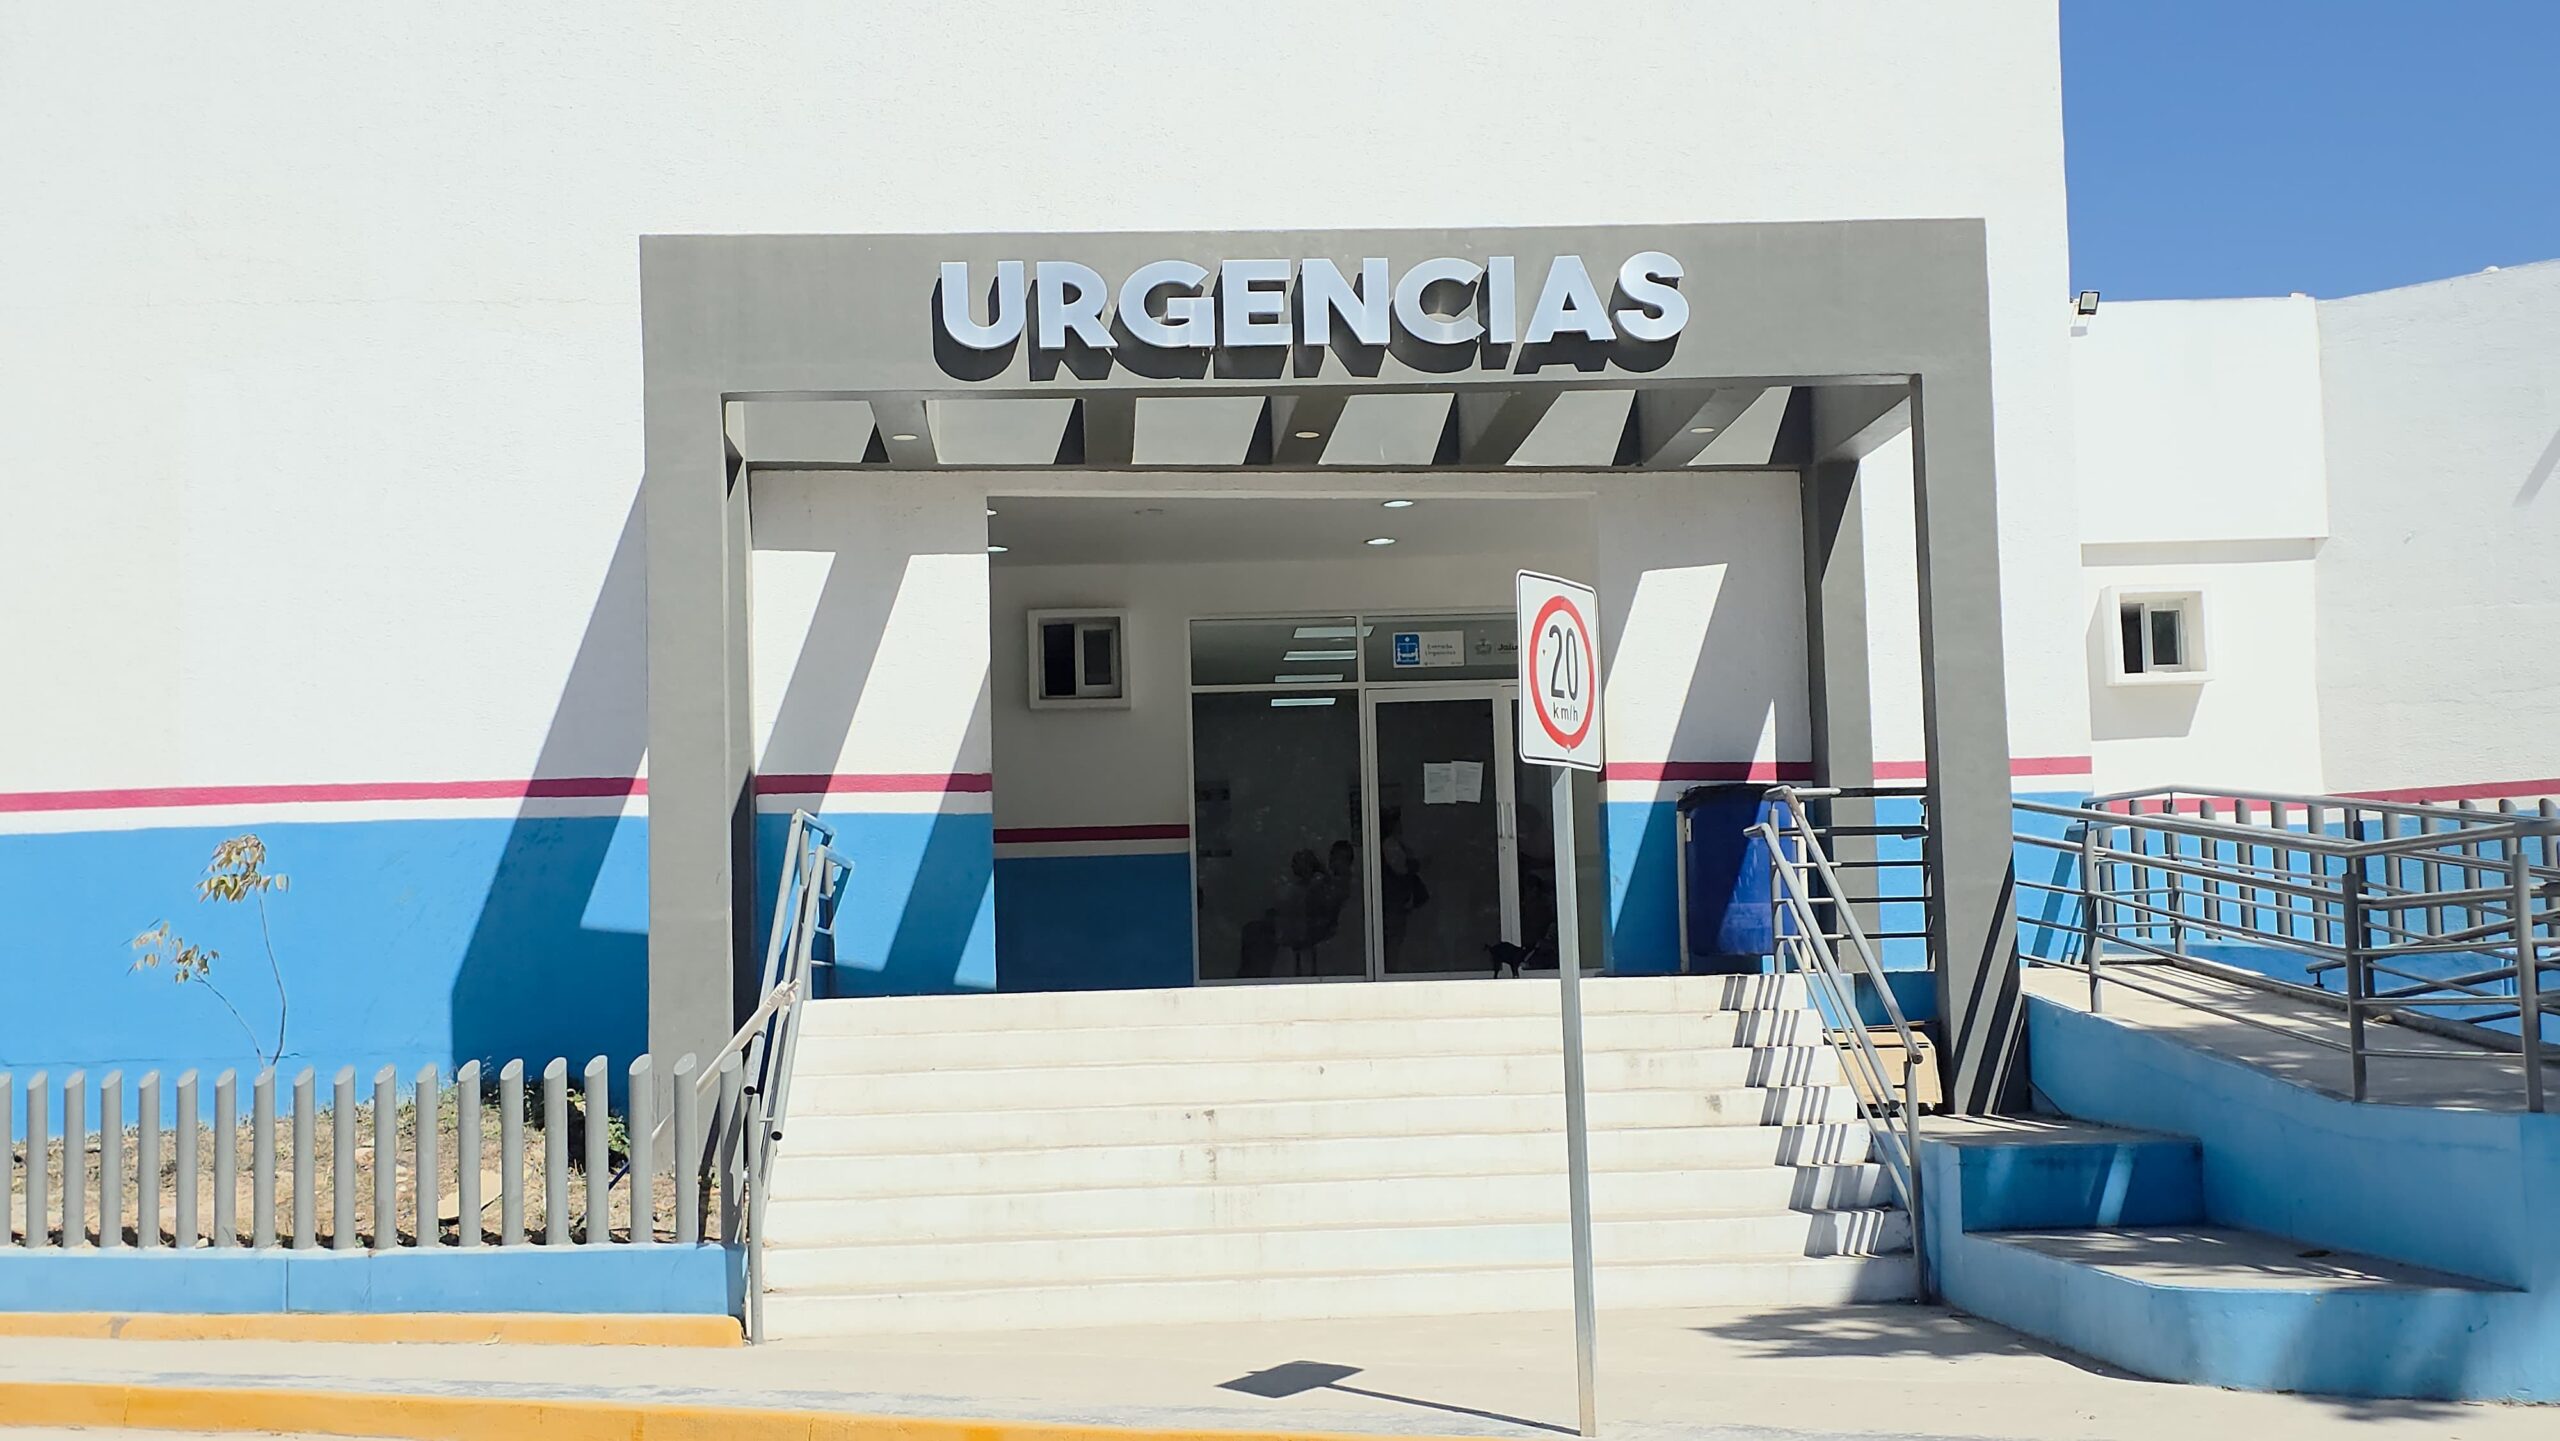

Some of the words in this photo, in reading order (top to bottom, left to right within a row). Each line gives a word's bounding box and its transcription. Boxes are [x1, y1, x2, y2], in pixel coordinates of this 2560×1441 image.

[940, 251, 1690, 349] URGENCIAS
[1549, 624, 1579, 701] 20
[1552, 702, 1579, 722] km/h
